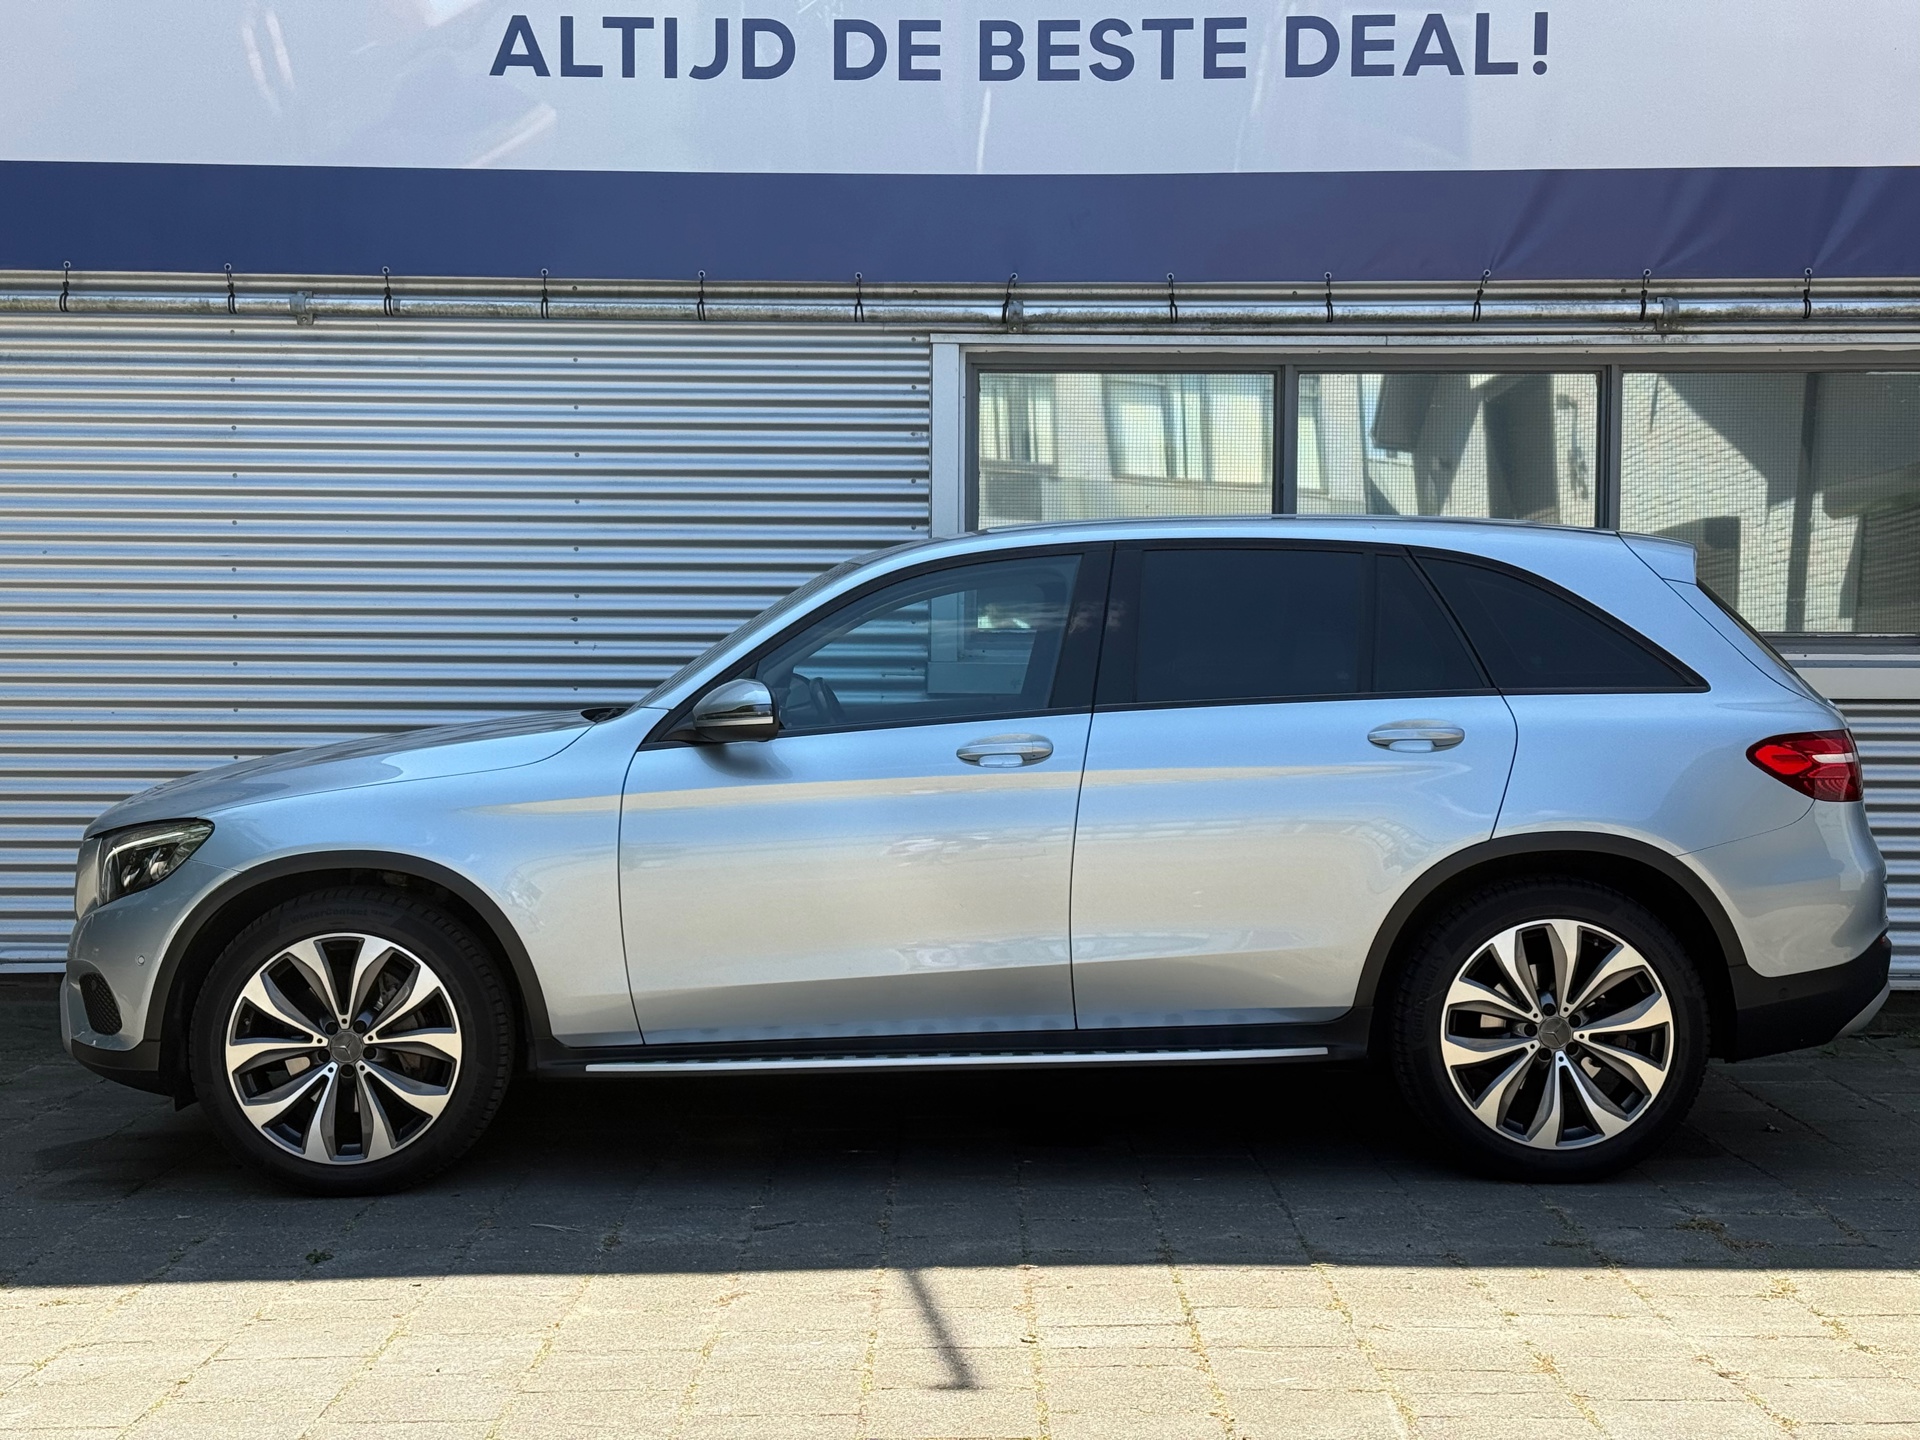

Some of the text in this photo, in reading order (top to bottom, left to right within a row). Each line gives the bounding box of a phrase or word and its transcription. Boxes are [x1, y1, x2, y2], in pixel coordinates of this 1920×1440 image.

[489, 11, 1549, 82] ALTIJD DE BESTE DEAL!
[290, 906, 369, 925] WinterContact
